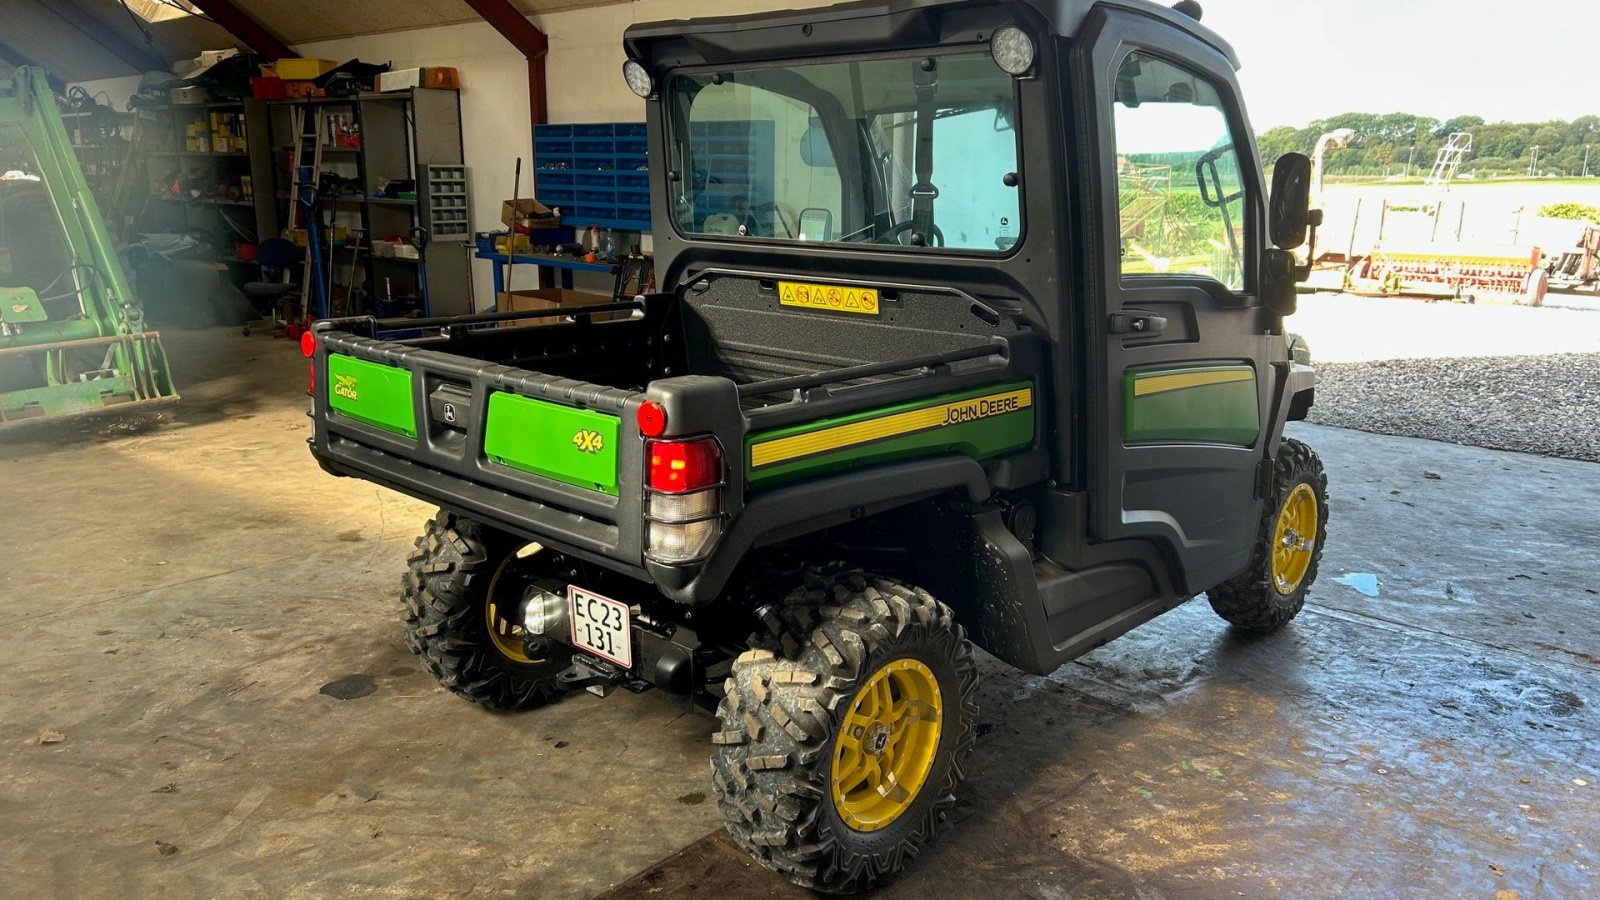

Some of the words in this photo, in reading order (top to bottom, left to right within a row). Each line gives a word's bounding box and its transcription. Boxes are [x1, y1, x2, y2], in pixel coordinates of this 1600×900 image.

[335, 384, 357, 400] GATOR
[943, 404, 977, 424] JOHN
[980, 396, 1018, 415] DEERE
[575, 593, 622, 631] EC23
[585, 623, 615, 656] 131
